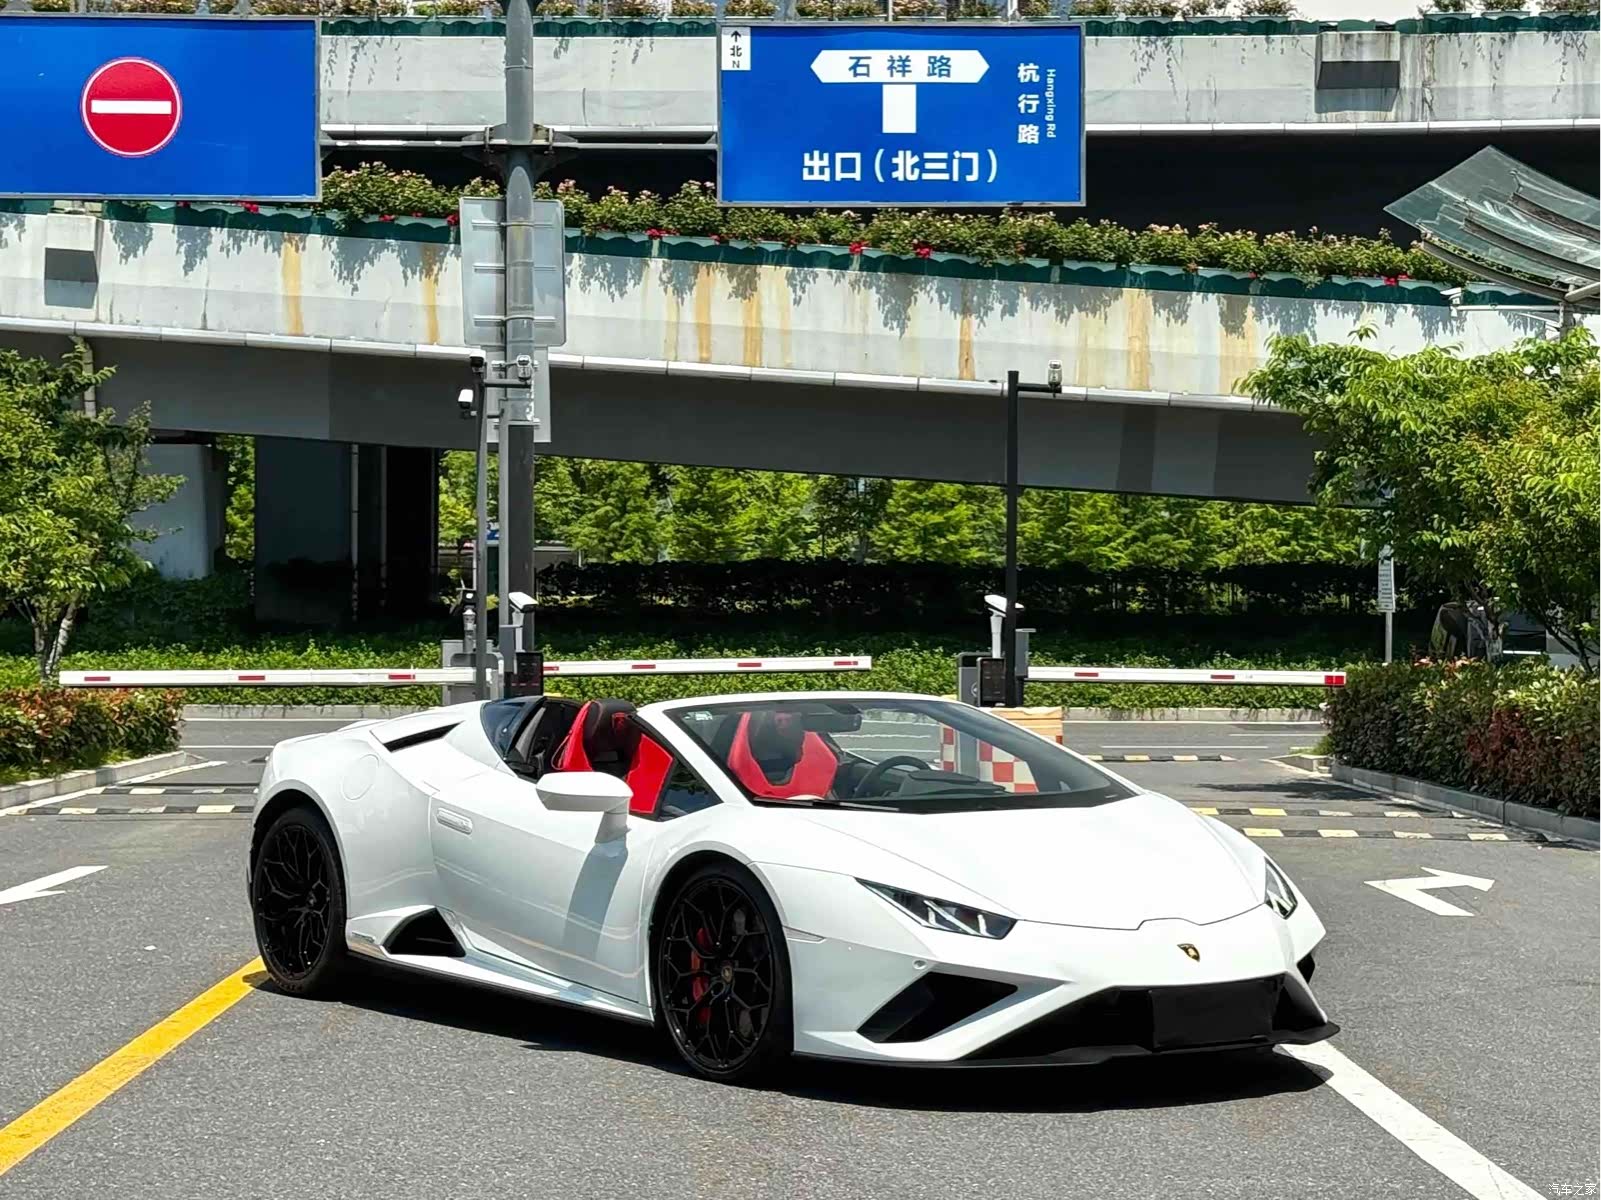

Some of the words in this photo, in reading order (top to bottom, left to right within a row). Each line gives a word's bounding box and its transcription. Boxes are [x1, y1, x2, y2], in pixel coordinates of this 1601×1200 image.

[729, 44, 743, 57] 北
[732, 60, 740, 69] N
[848, 55, 952, 78] 石祥路
[1017, 62, 1040, 144] 杭行路
[1045, 68, 1056, 121] Hangxing
[1046, 123, 1056, 138] Rd
